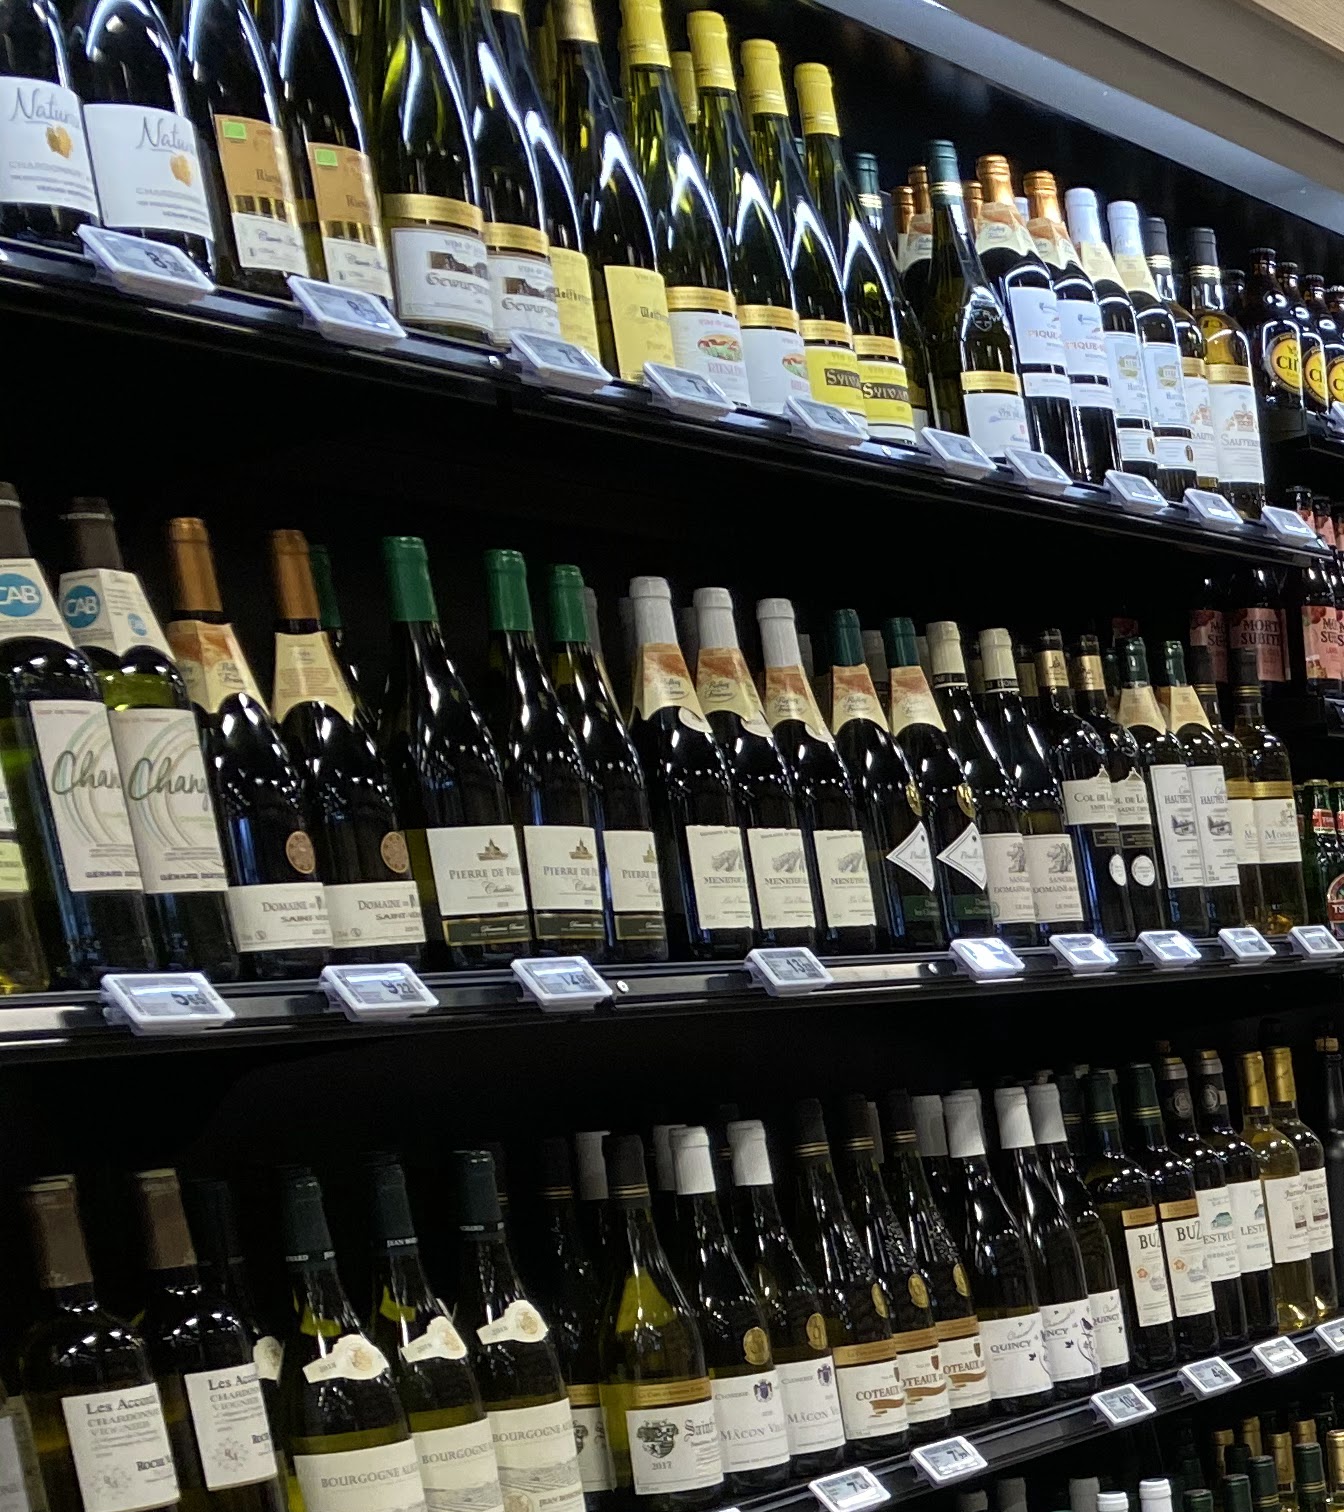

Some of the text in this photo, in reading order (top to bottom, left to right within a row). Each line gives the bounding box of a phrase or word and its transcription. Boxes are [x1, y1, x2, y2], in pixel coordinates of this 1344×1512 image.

[64, 596, 97, 618] CAB
[1243, 619, 1278, 632] MORT
[450, 867, 488, 880] PIERRE
[543, 865, 577, 877] PIERRE
[989, 1339, 1033, 1353] QUINCY
[208, 1377, 232, 1391] Les
[86, 1402, 113, 1415] Les
[651, 1461, 673, 1471] 2017
[321, 1468, 398, 1489] BOURGOGNE
